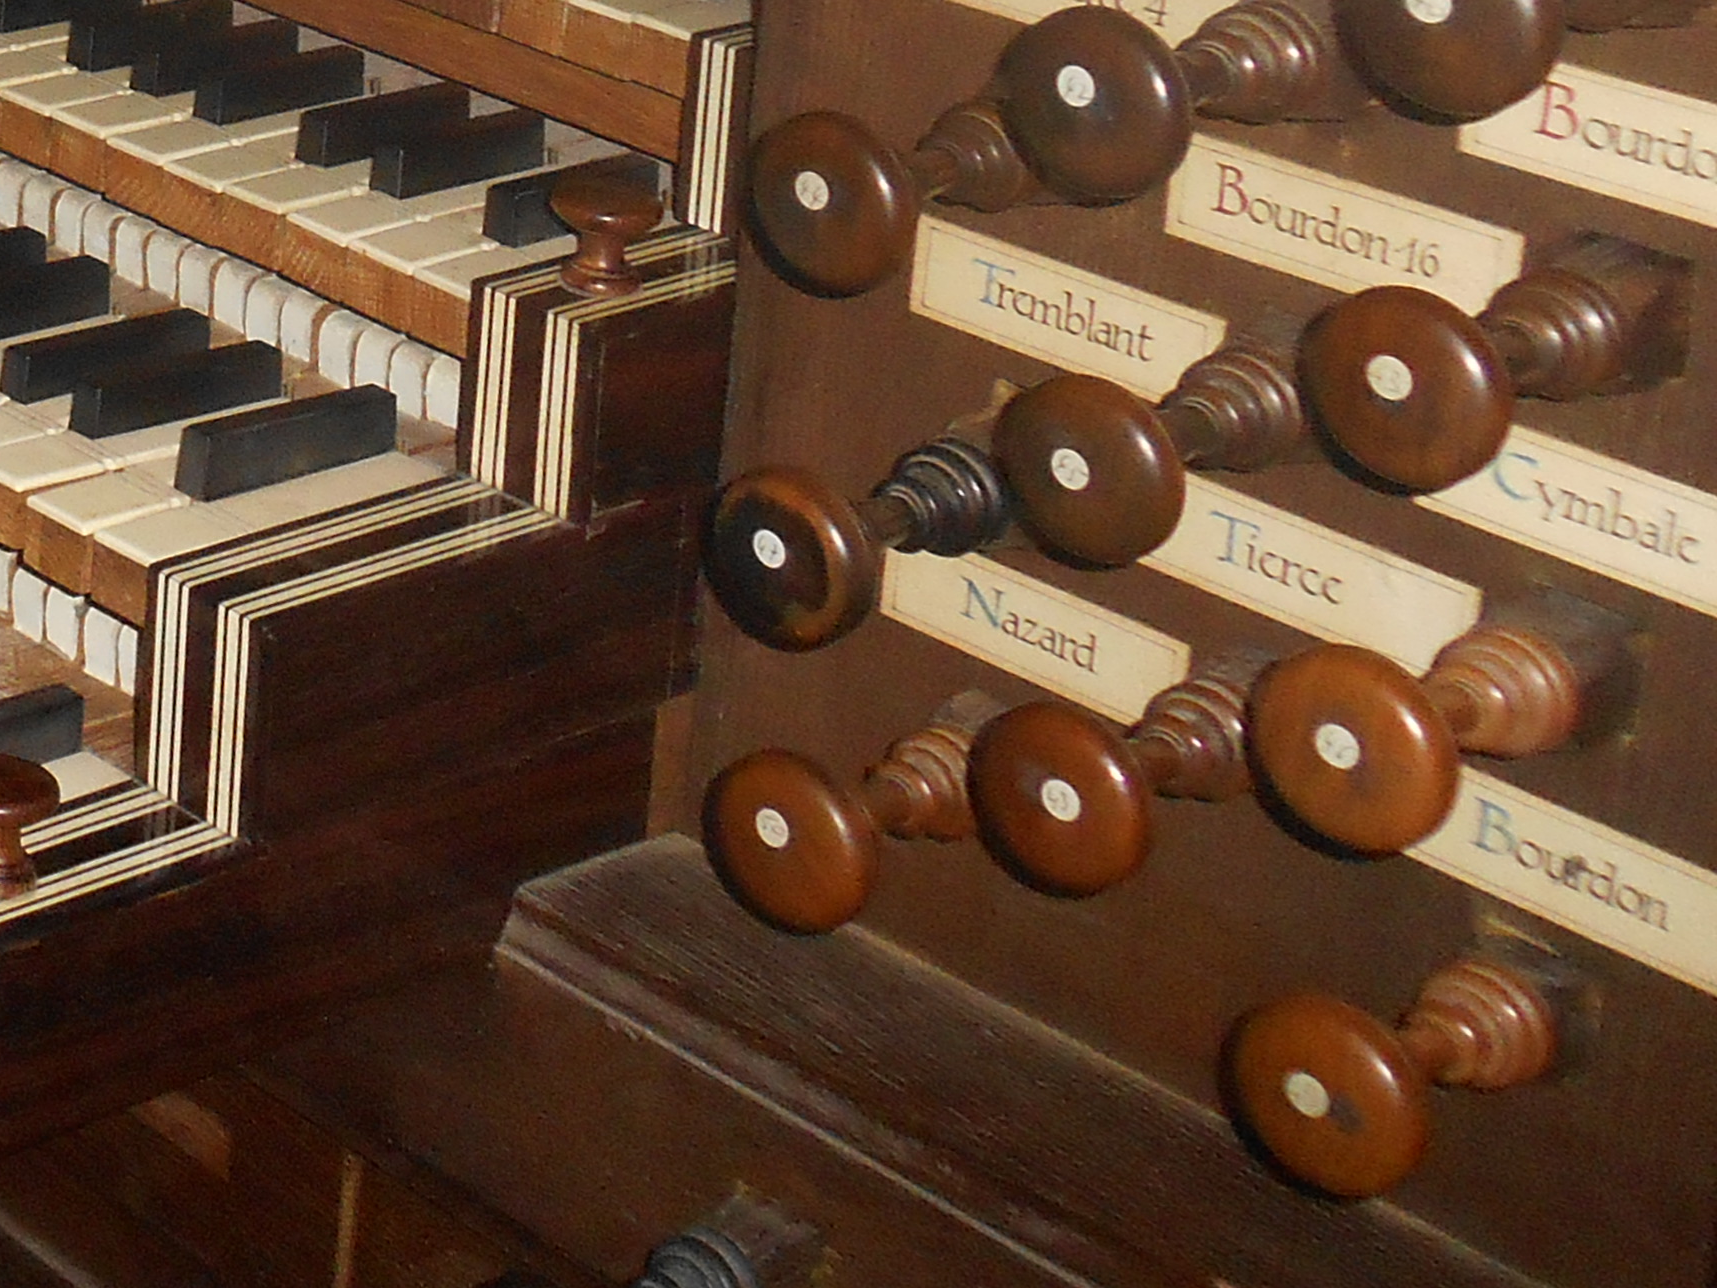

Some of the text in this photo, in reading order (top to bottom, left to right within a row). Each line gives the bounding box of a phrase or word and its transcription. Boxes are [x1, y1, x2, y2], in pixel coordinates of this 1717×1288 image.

[972, 257, 1154, 362] Tremblant
[1209, 509, 1344, 606] Tierce
[1487, 451, 1700, 564] Cymbale
[959, 576, 1099, 676] Nazard
[1469, 796, 1670, 932] Bourdon
